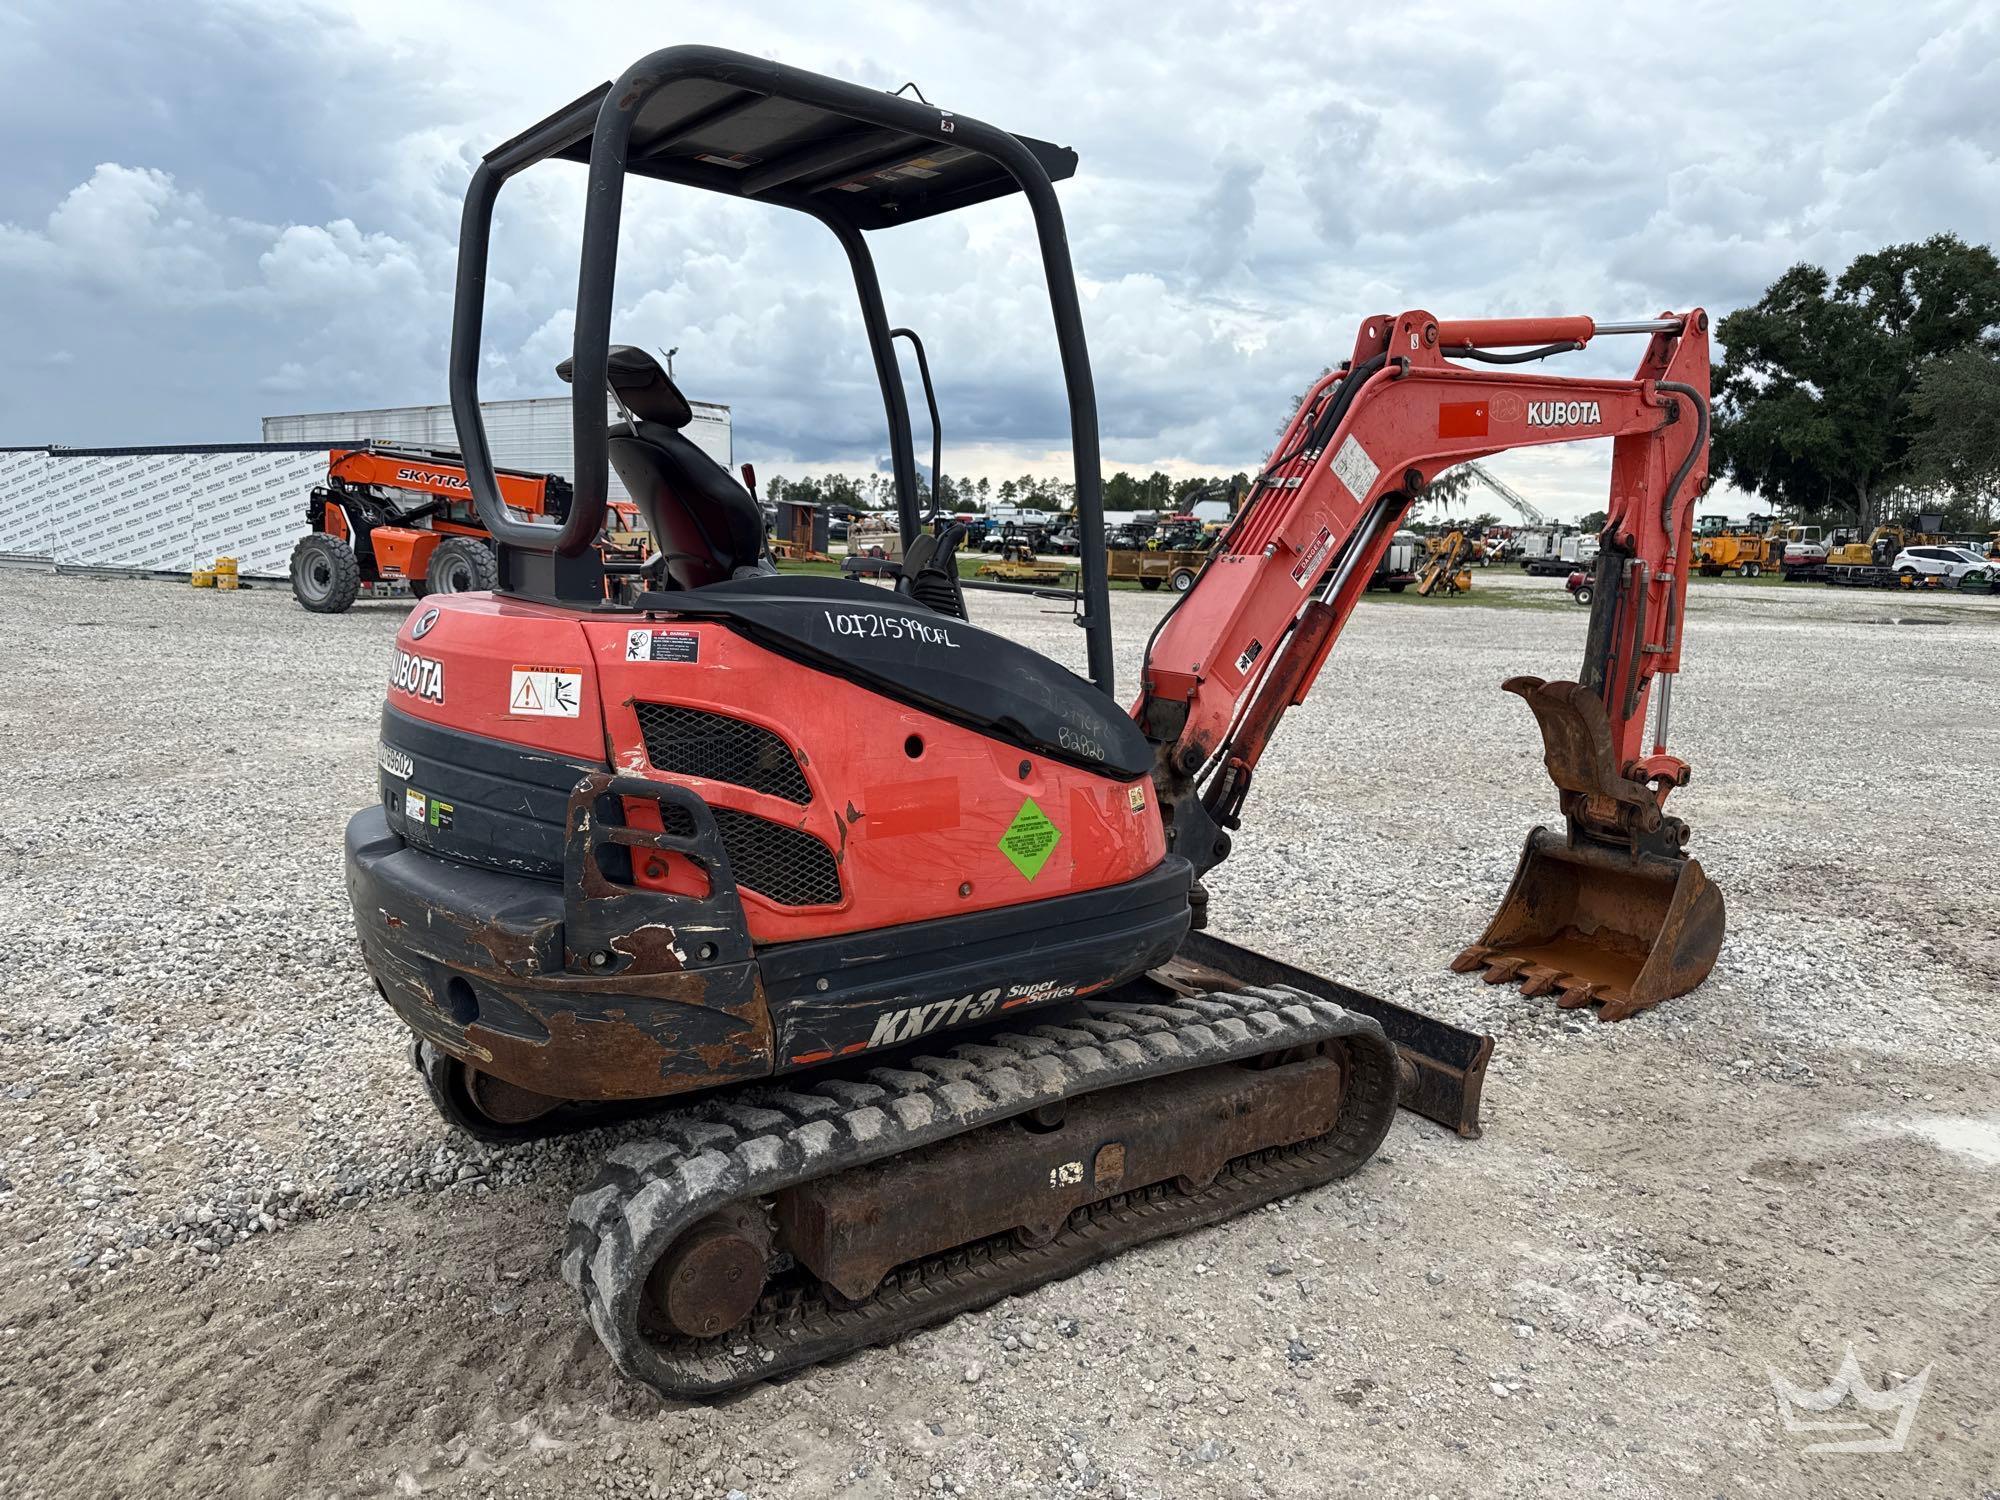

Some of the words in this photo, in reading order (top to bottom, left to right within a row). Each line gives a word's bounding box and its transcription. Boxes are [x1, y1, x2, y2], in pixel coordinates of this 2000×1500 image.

[1527, 401, 1602, 425] KUBOTA
[397, 468, 471, 491] SKYTRA
[1301, 539, 1323, 569] DANGER
[1833, 547, 1844, 555] CAT
[391, 651, 443, 699] UBOTA
[529, 666, 566, 674] WARNING
[1006, 979, 1056, 998] Super
[1028, 985, 1076, 1003] Series
[867, 988, 1001, 1049] KX71-3
